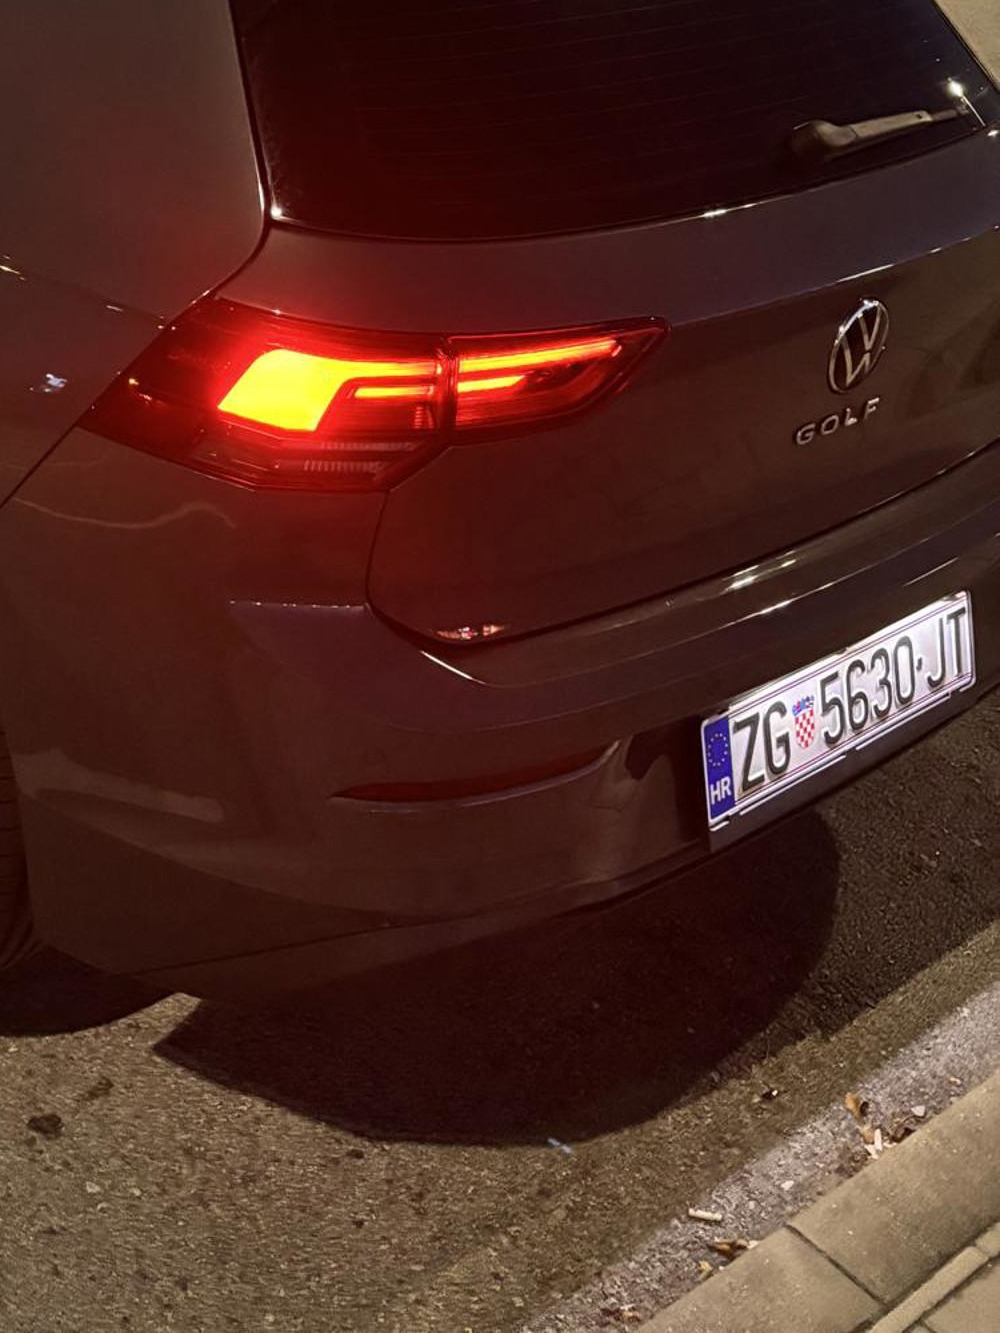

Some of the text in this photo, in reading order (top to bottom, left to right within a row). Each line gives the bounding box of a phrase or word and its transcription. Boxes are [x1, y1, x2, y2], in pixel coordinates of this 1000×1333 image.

[795, 396, 880, 446] GOLF
[732, 700, 791, 794] ZG
[710, 775, 732, 805] HR
